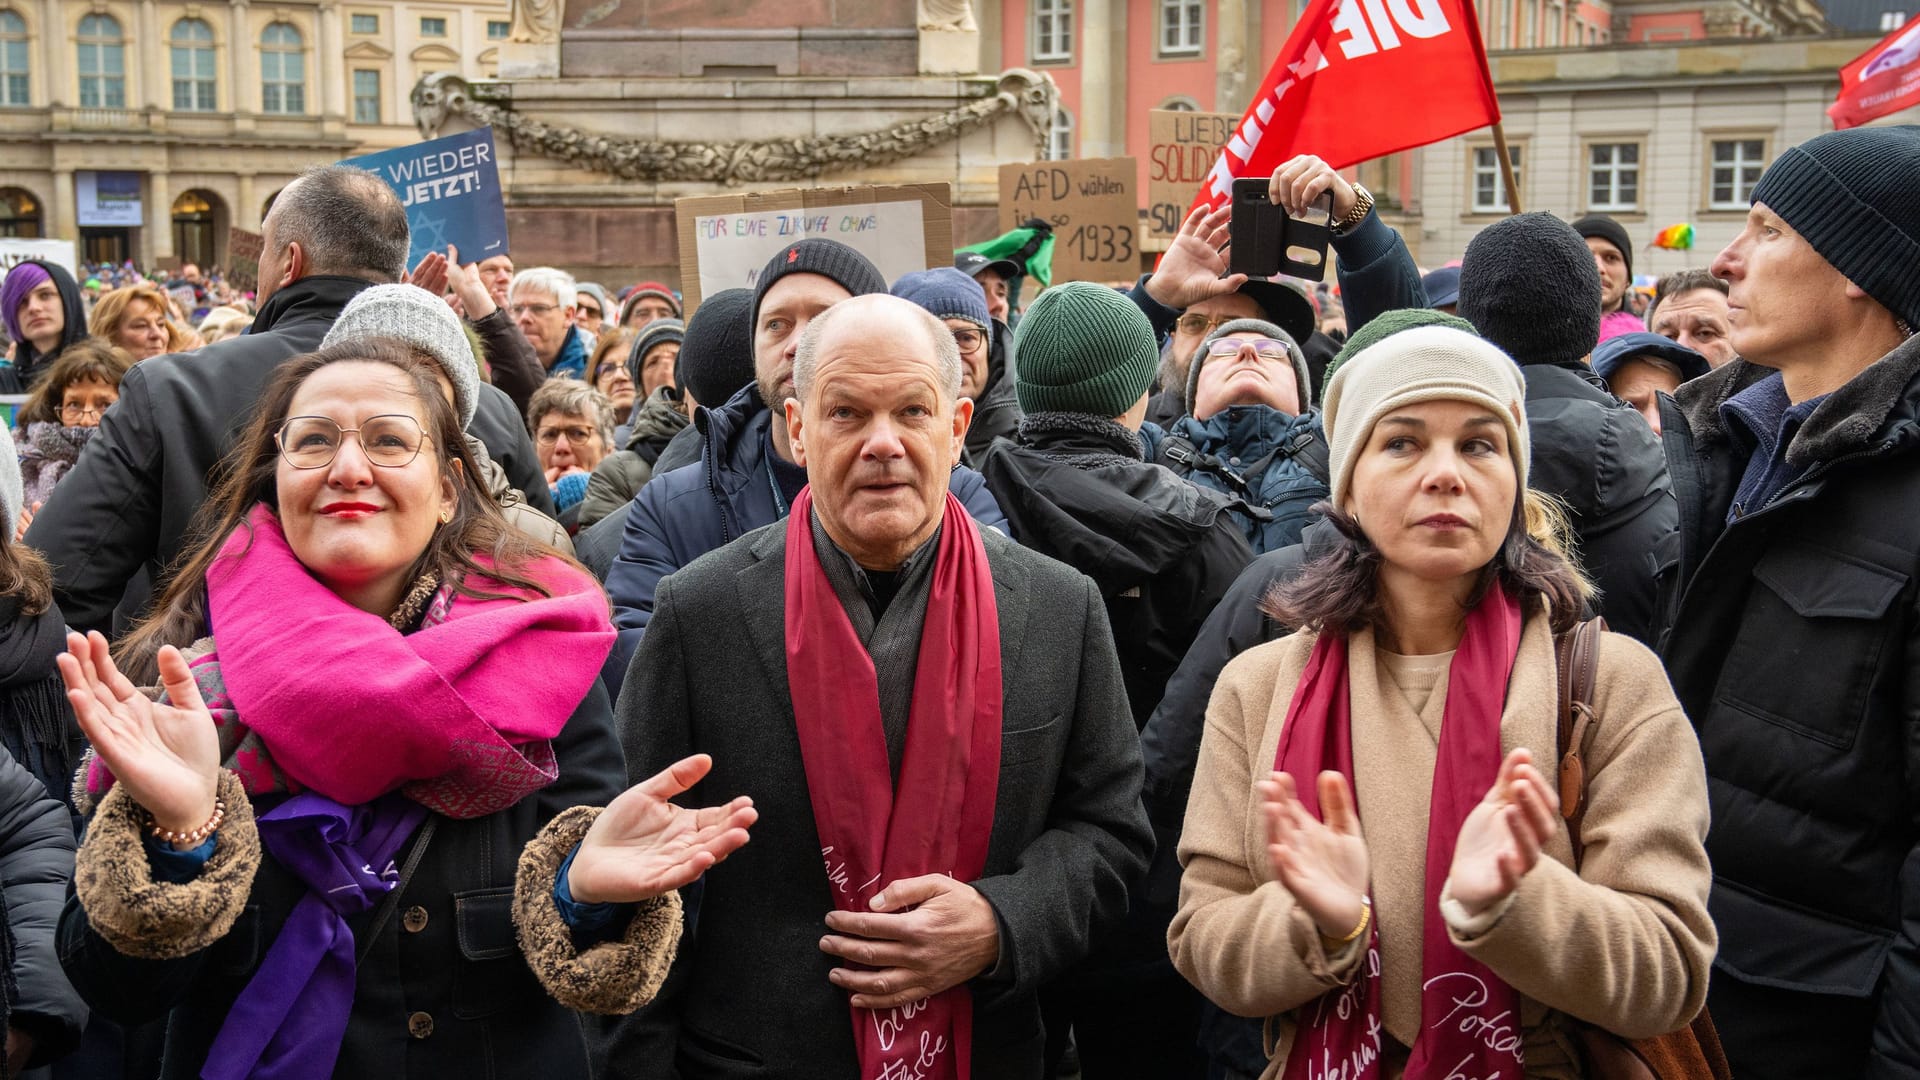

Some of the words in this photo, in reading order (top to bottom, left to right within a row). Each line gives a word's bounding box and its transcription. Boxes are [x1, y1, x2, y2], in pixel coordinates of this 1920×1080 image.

[388, 143, 490, 183] WIEDER
[403, 170, 481, 207] JETZT!
[1014, 169, 1069, 201] AfD
[1078, 175, 1125, 197] wählen
[736, 218, 767, 237] EINE
[840, 215, 876, 232] OHNE
[1051, 214, 1070, 228] so
[1067, 225, 1132, 263] 1933
